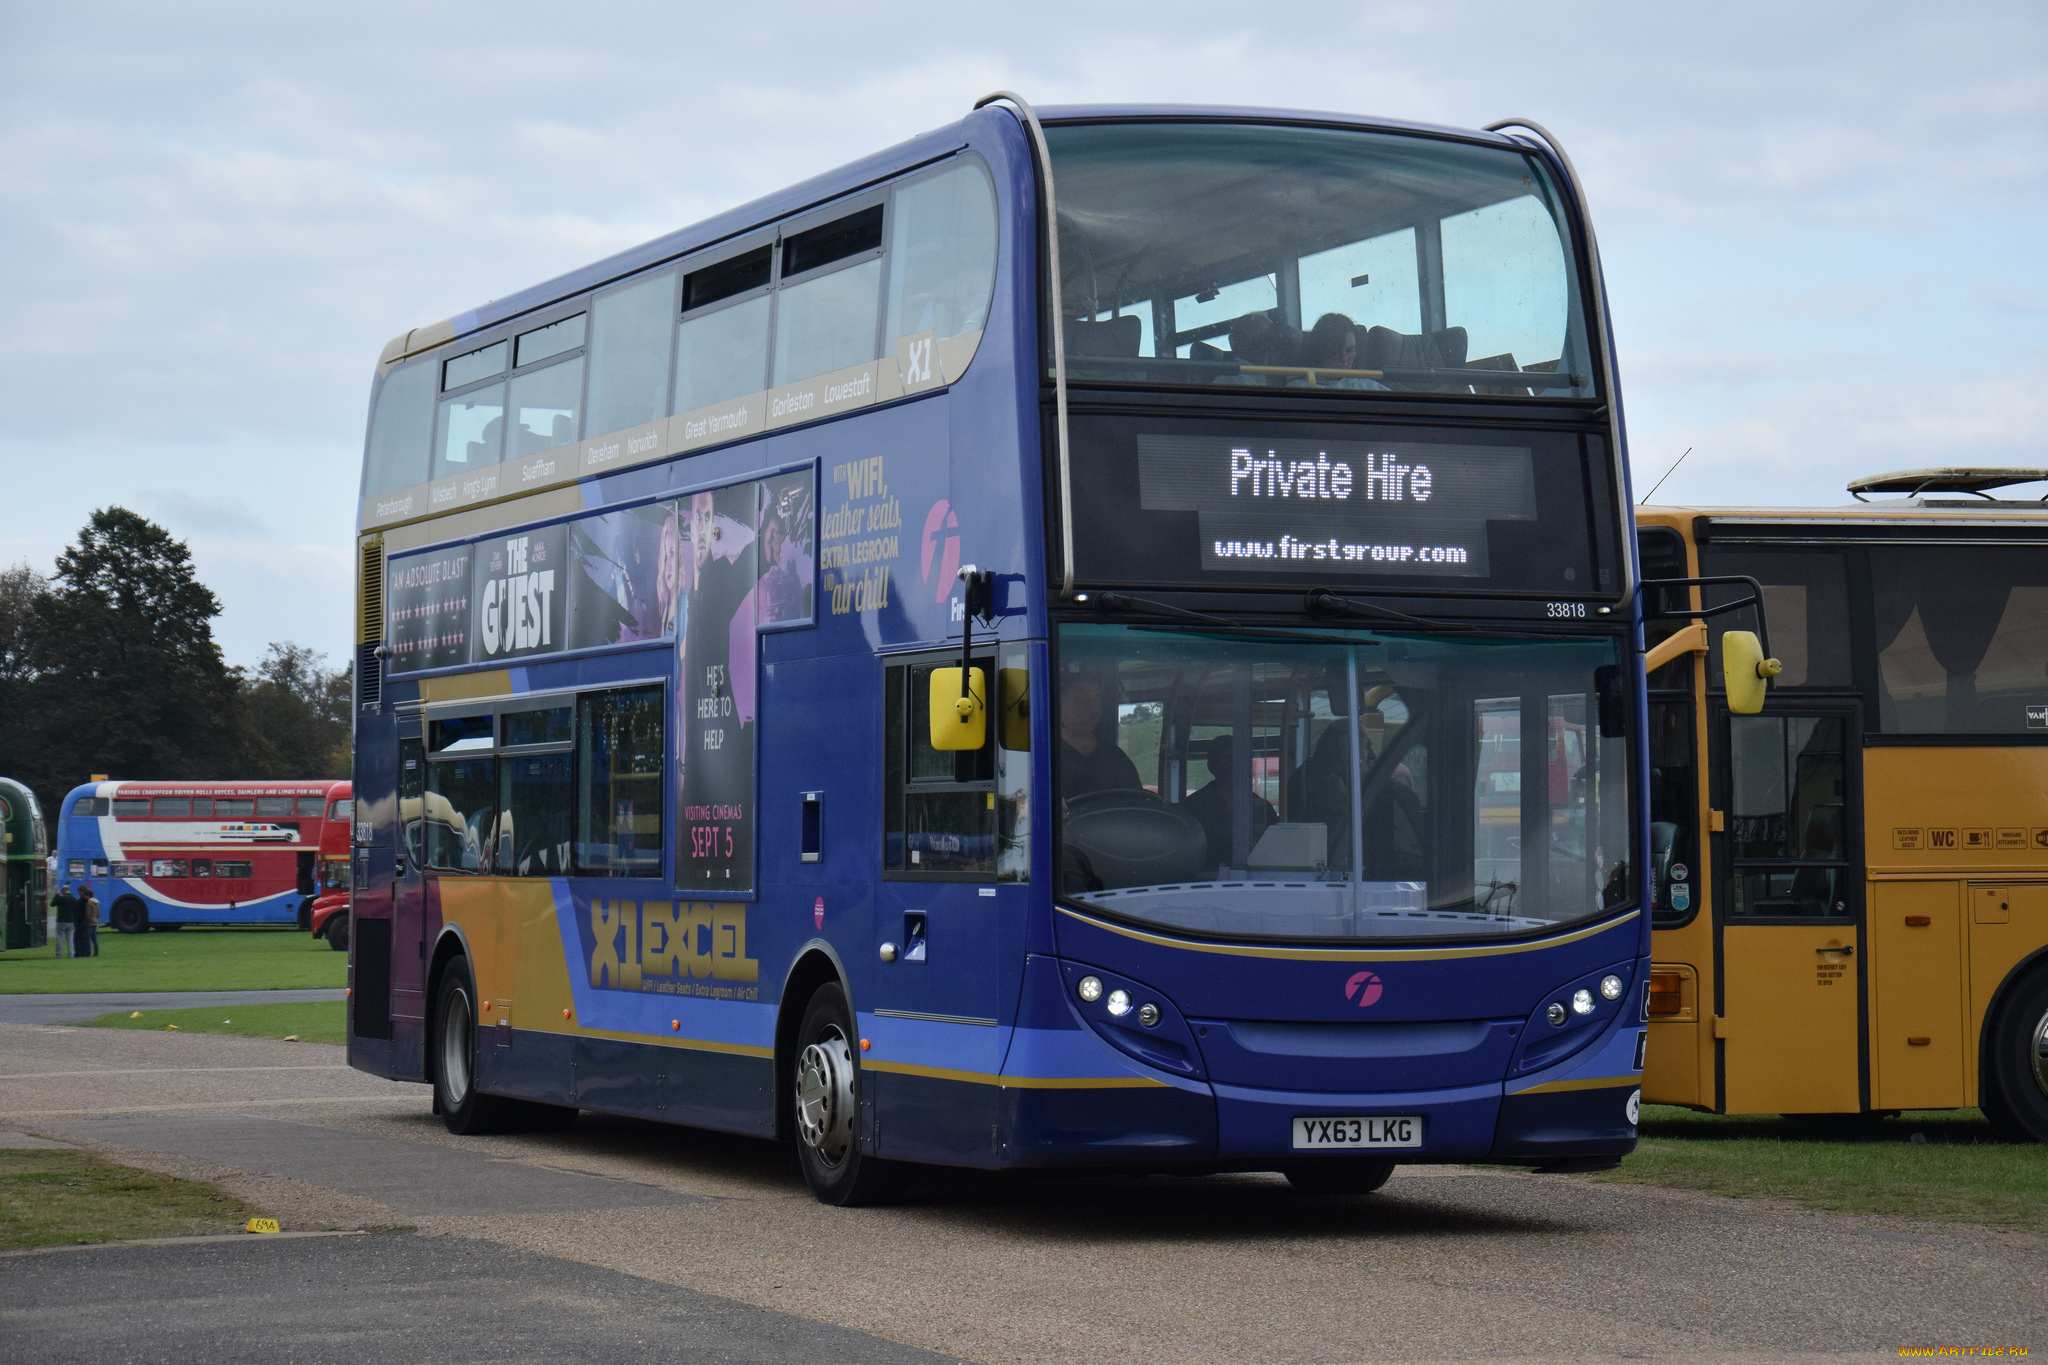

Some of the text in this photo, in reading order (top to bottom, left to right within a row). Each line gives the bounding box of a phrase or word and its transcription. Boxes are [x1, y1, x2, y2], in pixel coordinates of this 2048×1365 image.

[907, 338, 932, 385] X1
[772, 372, 871, 418] Gorleston Lowestoft
[685, 406, 748, 441] Great Yarmouth
[588, 429, 658, 465] Dereham Norwich
[522, 458, 555, 482] Swaffham
[833, 455, 888, 501] WITH WIFI,
[1231, 448, 1433, 502] Private Hire
[432, 475, 496, 504] Wisbech King's Lynn
[376, 493, 413, 518] Peterborough
[821, 494, 902, 541] leather seats,
[507, 536, 529, 576] THE
[821, 535, 899, 571] EXTRA LEGROOM
[1214, 535, 1467, 564] www.firstgroup.com
[405, 562, 440, 589] ABSOLUTE
[823, 565, 889, 616] AND air chill
[481, 569, 554, 655] GUEST
[1546, 602, 1586, 618] 33818
[707, 665, 724, 687] HE'S
[697, 697, 732, 719] HERE TO
[704, 729, 724, 750] HELP
[685, 803, 742, 821] VISITING CINEMAS
[356, 822, 373, 840] 33818
[691, 827, 733, 857] SEPT 5
[1932, 831, 1955, 847] WC
[591, 899, 758, 990] X1 EXCEL
[657, 981, 676, 994] Leather
[677, 982, 691, 995] Seats
[696, 983, 710, 997] Extra
[710, 985, 732, 1001] Legroom
[737, 986, 746, 999] Air
[746, 986, 758, 1001] Chill
[1303, 1119, 1412, 1143] YX63 LKG
